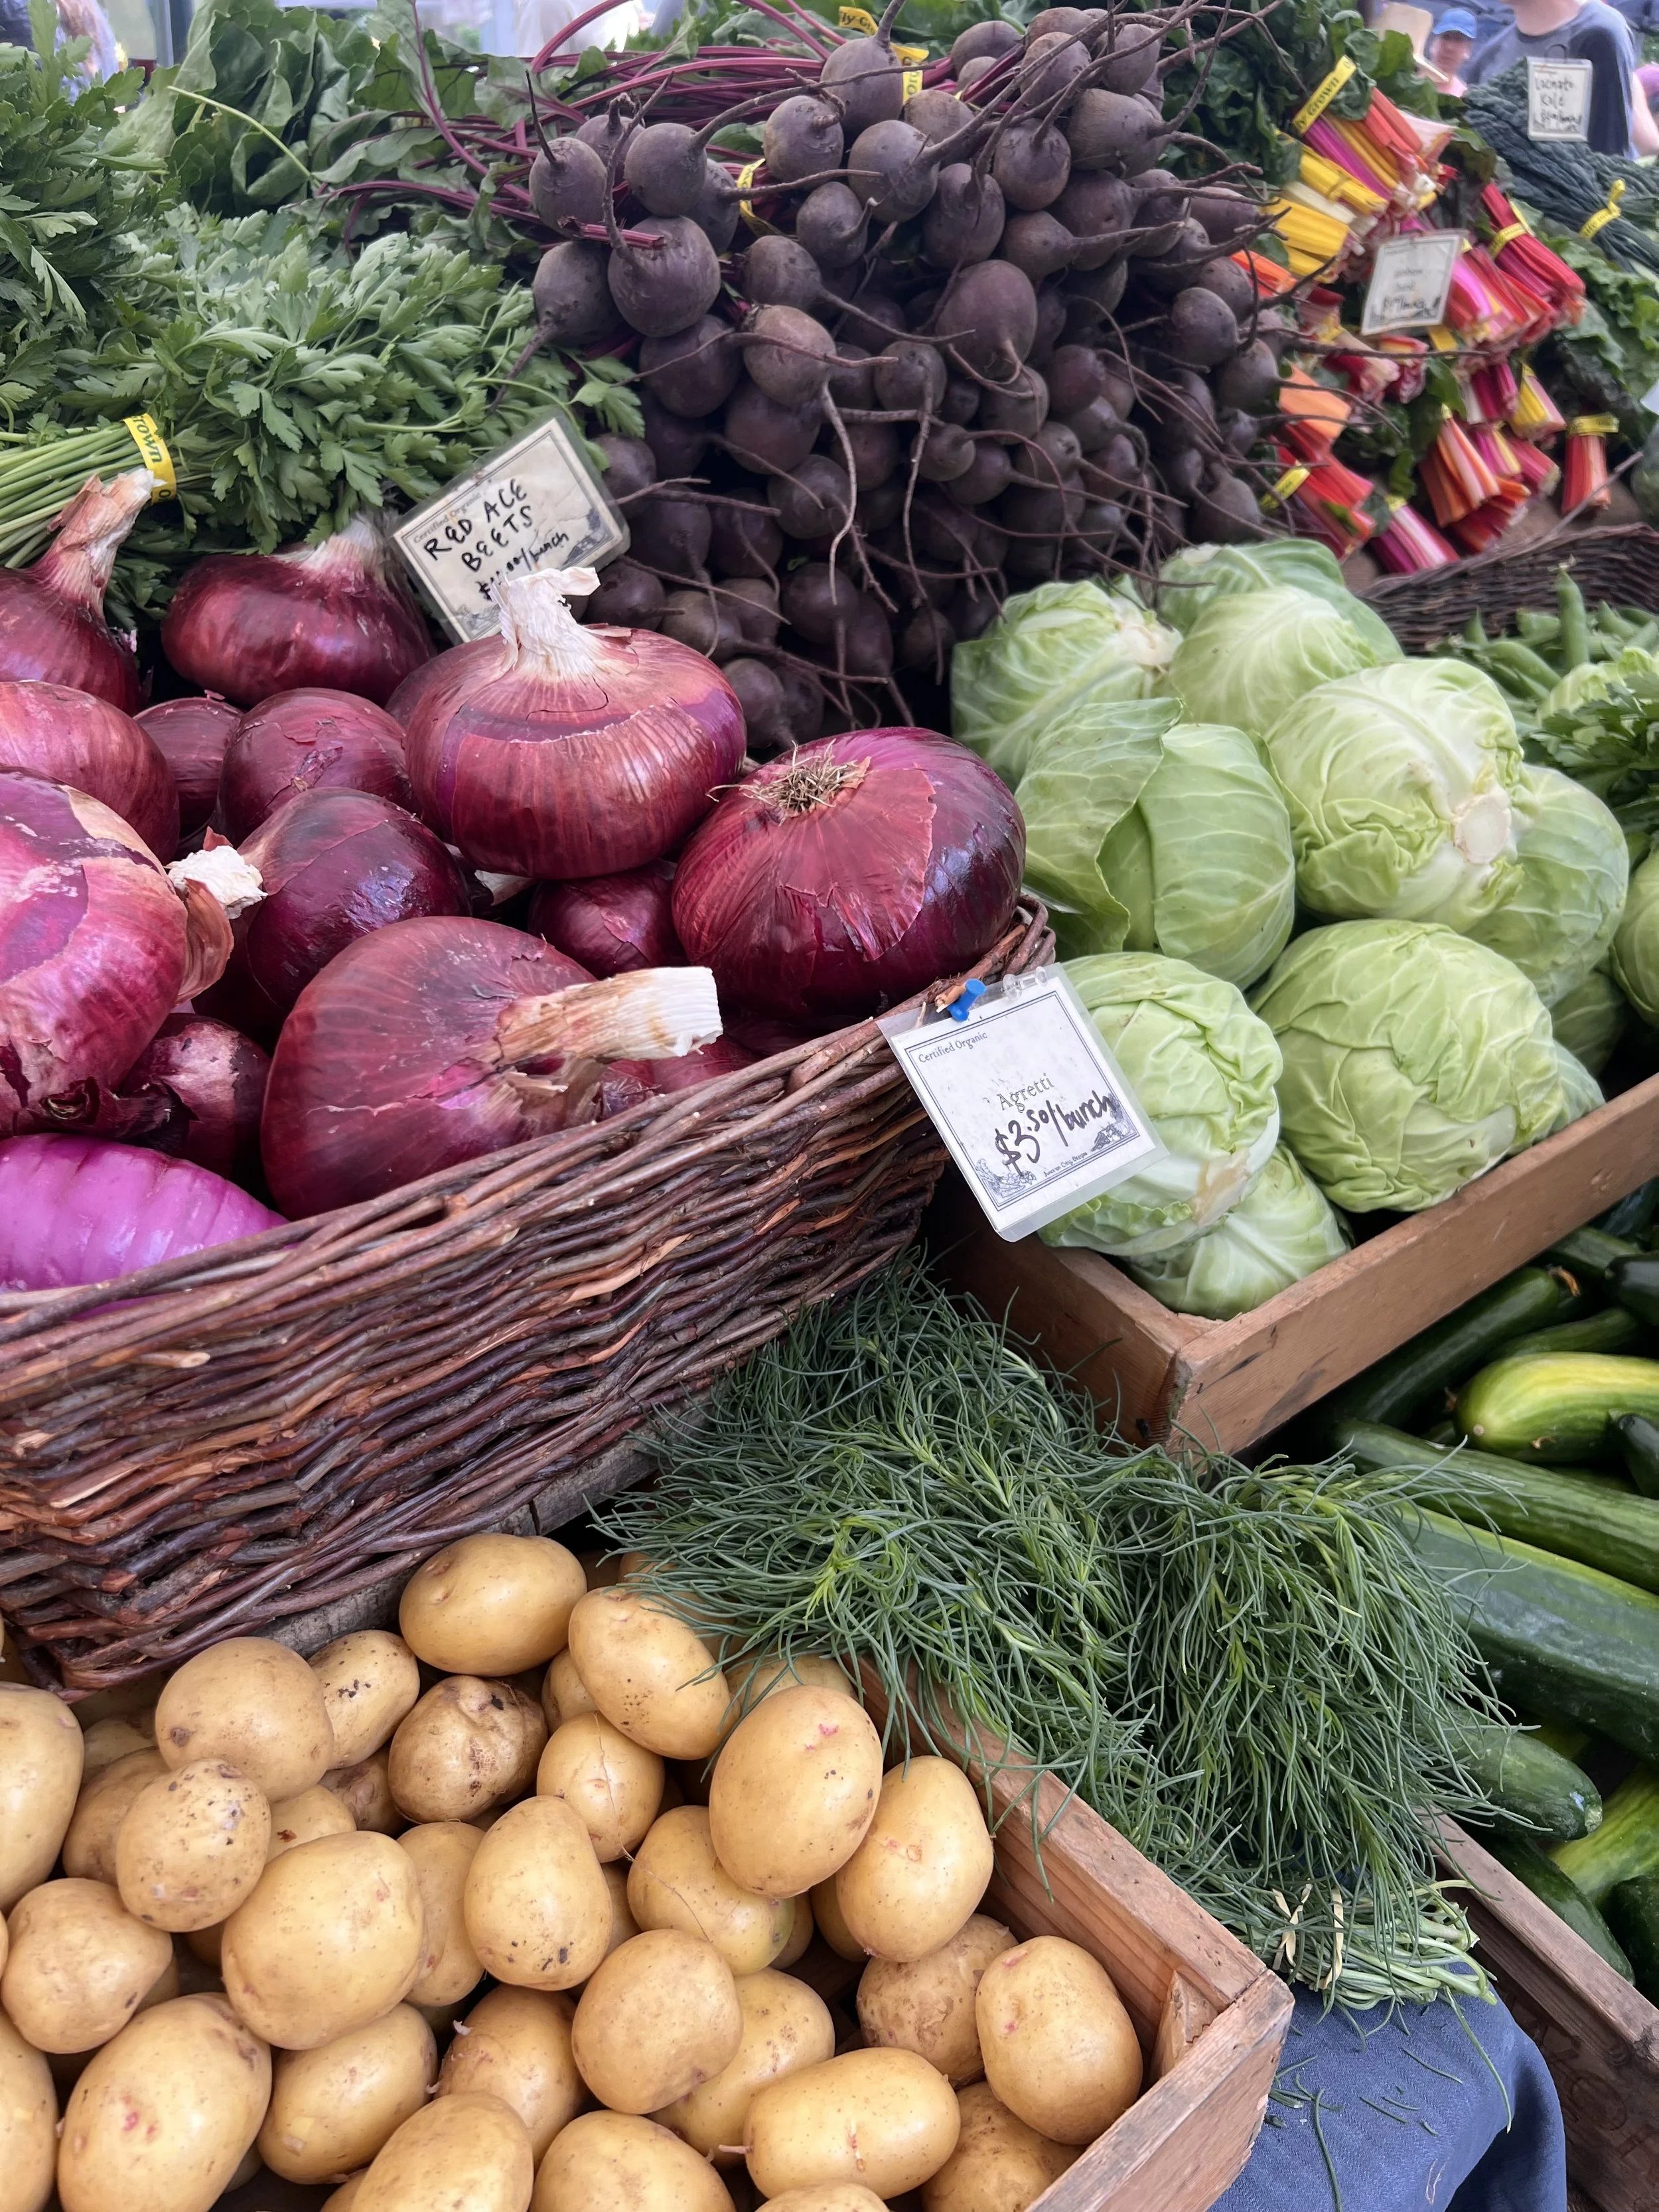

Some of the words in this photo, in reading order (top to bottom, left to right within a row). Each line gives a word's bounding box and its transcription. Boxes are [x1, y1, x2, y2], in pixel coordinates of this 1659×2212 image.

[1307, 76, 1339, 115] Grown
[414, 516, 449, 543] Certified
[450, 493, 482, 518] Organic
[423, 518, 472, 561] RED
[483, 479, 528, 523] ACE
[462, 505, 533, 572] BEETS
[918, 1042, 956, 1063] Certified
[955, 1032, 988, 1050] Organic
[996, 1072, 1055, 1113] Agretti
[995, 1090, 1118, 1177] $3.50/bunch
